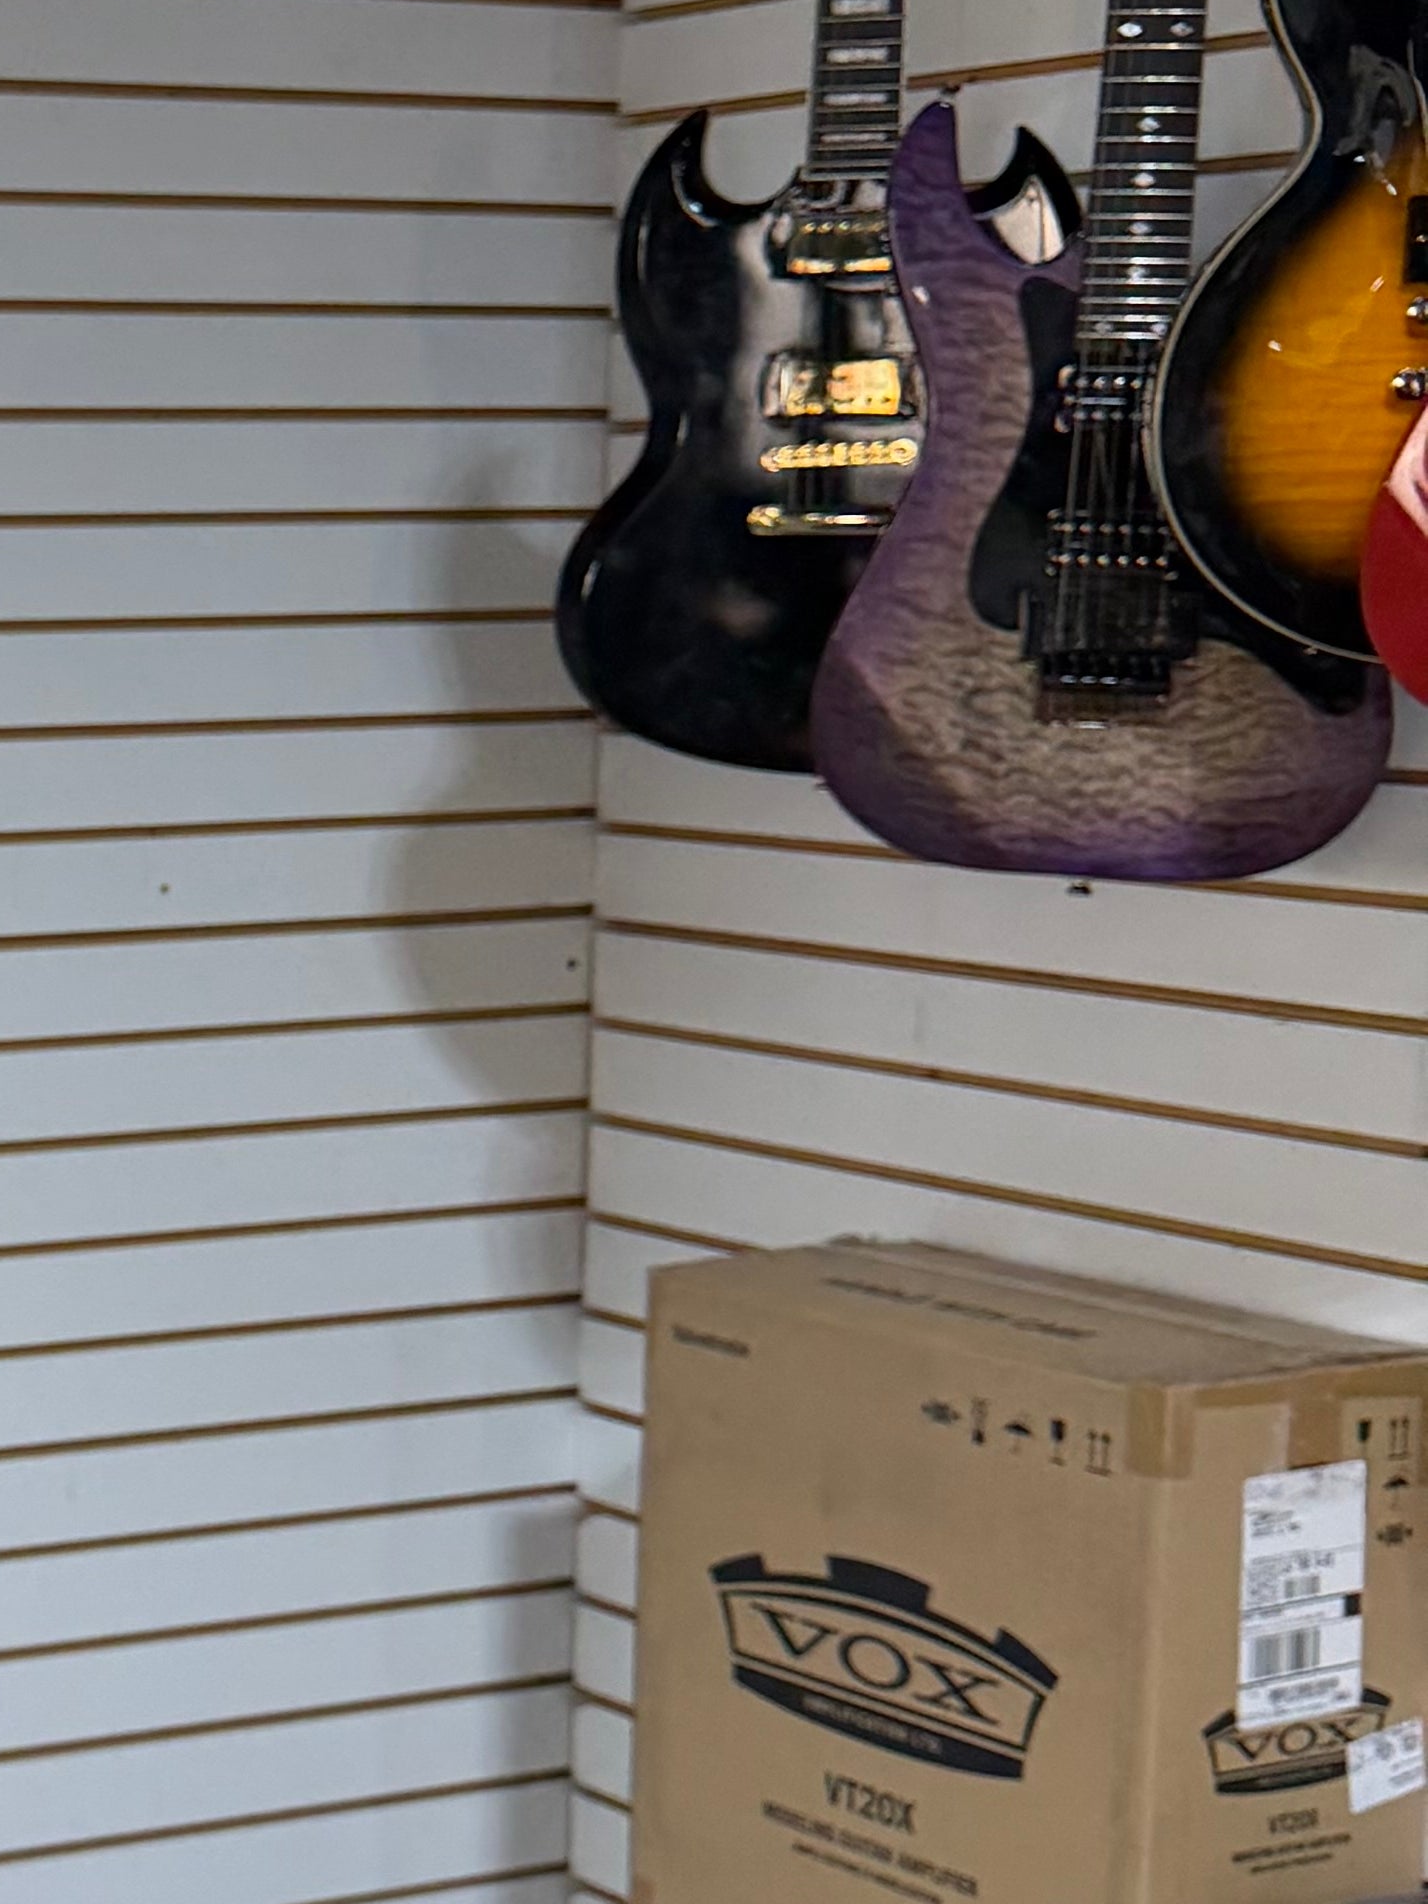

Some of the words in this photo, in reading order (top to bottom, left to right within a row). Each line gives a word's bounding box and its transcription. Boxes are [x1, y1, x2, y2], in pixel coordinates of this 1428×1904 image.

[749, 1599, 1001, 1727] VOX
[1225, 1715, 1366, 1761] VOX
[823, 1767, 918, 1835] VT20X
